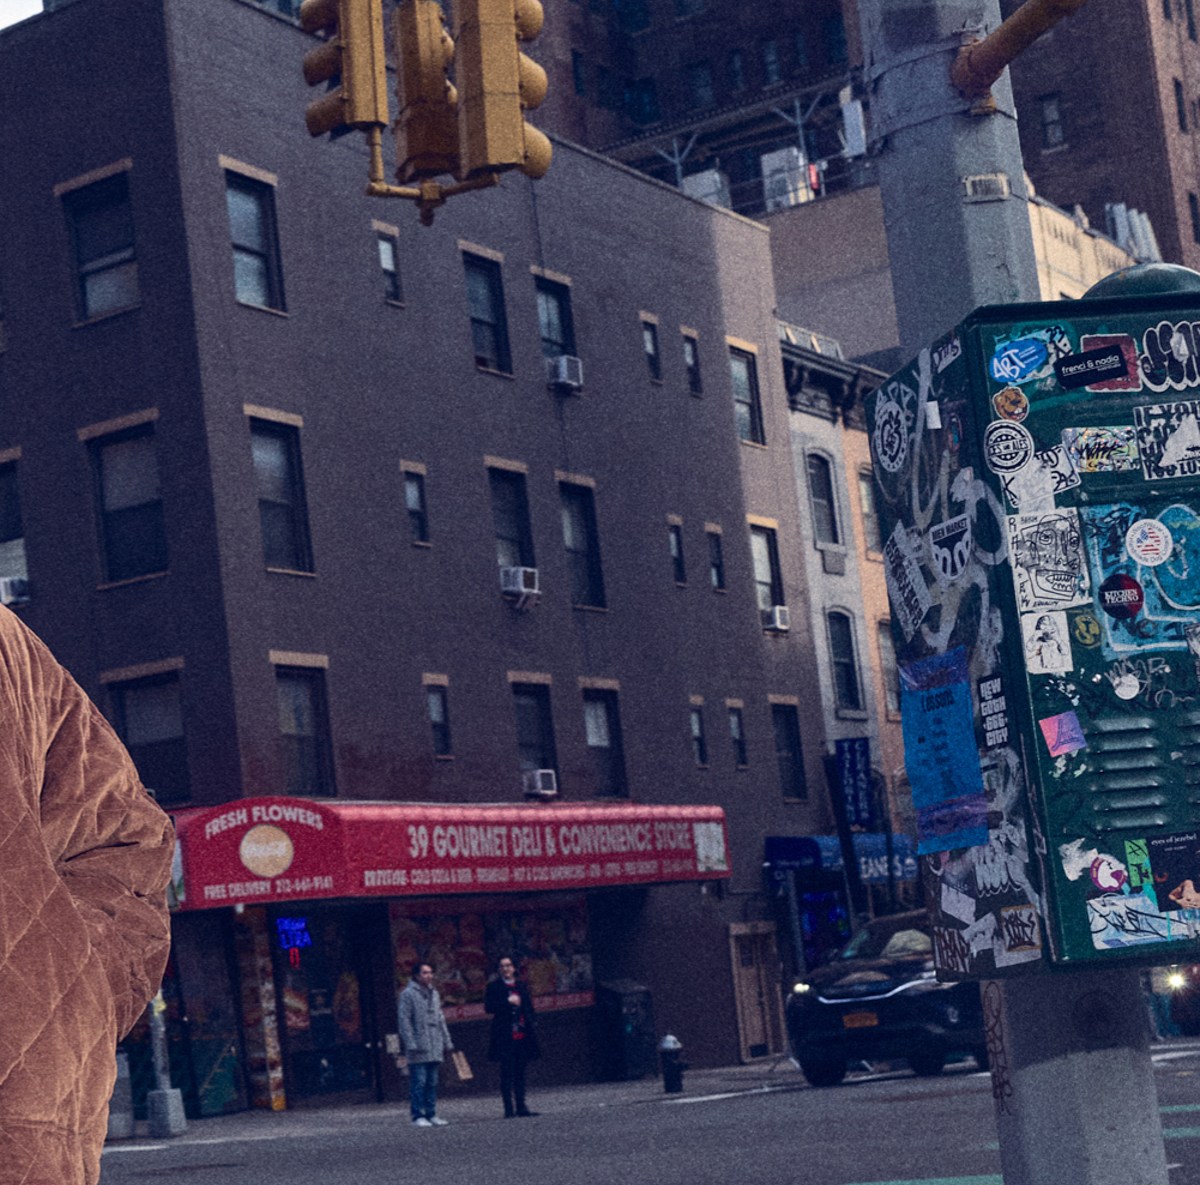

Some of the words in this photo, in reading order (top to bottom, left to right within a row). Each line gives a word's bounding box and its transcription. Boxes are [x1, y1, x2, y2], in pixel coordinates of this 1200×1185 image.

[1087, 359, 1095, 368] &
[1104, 588, 1138, 600] KITCHEN
[1105, 595, 1139, 604] TECHNO
[204, 807, 248, 840] FRESH
[252, 804, 324, 831] FLOWERS
[407, 825, 429, 858] 39
[433, 824, 508, 858] GOURMET
[511, 825, 543, 858] DELI
[544, 825, 557, 857] &
[559, 822, 652, 856] CONVENIENCE
[653, 821, 692, 851] STORE
[204, 883, 227, 899] FREE
[228, 880, 271, 898] DELIVERY
